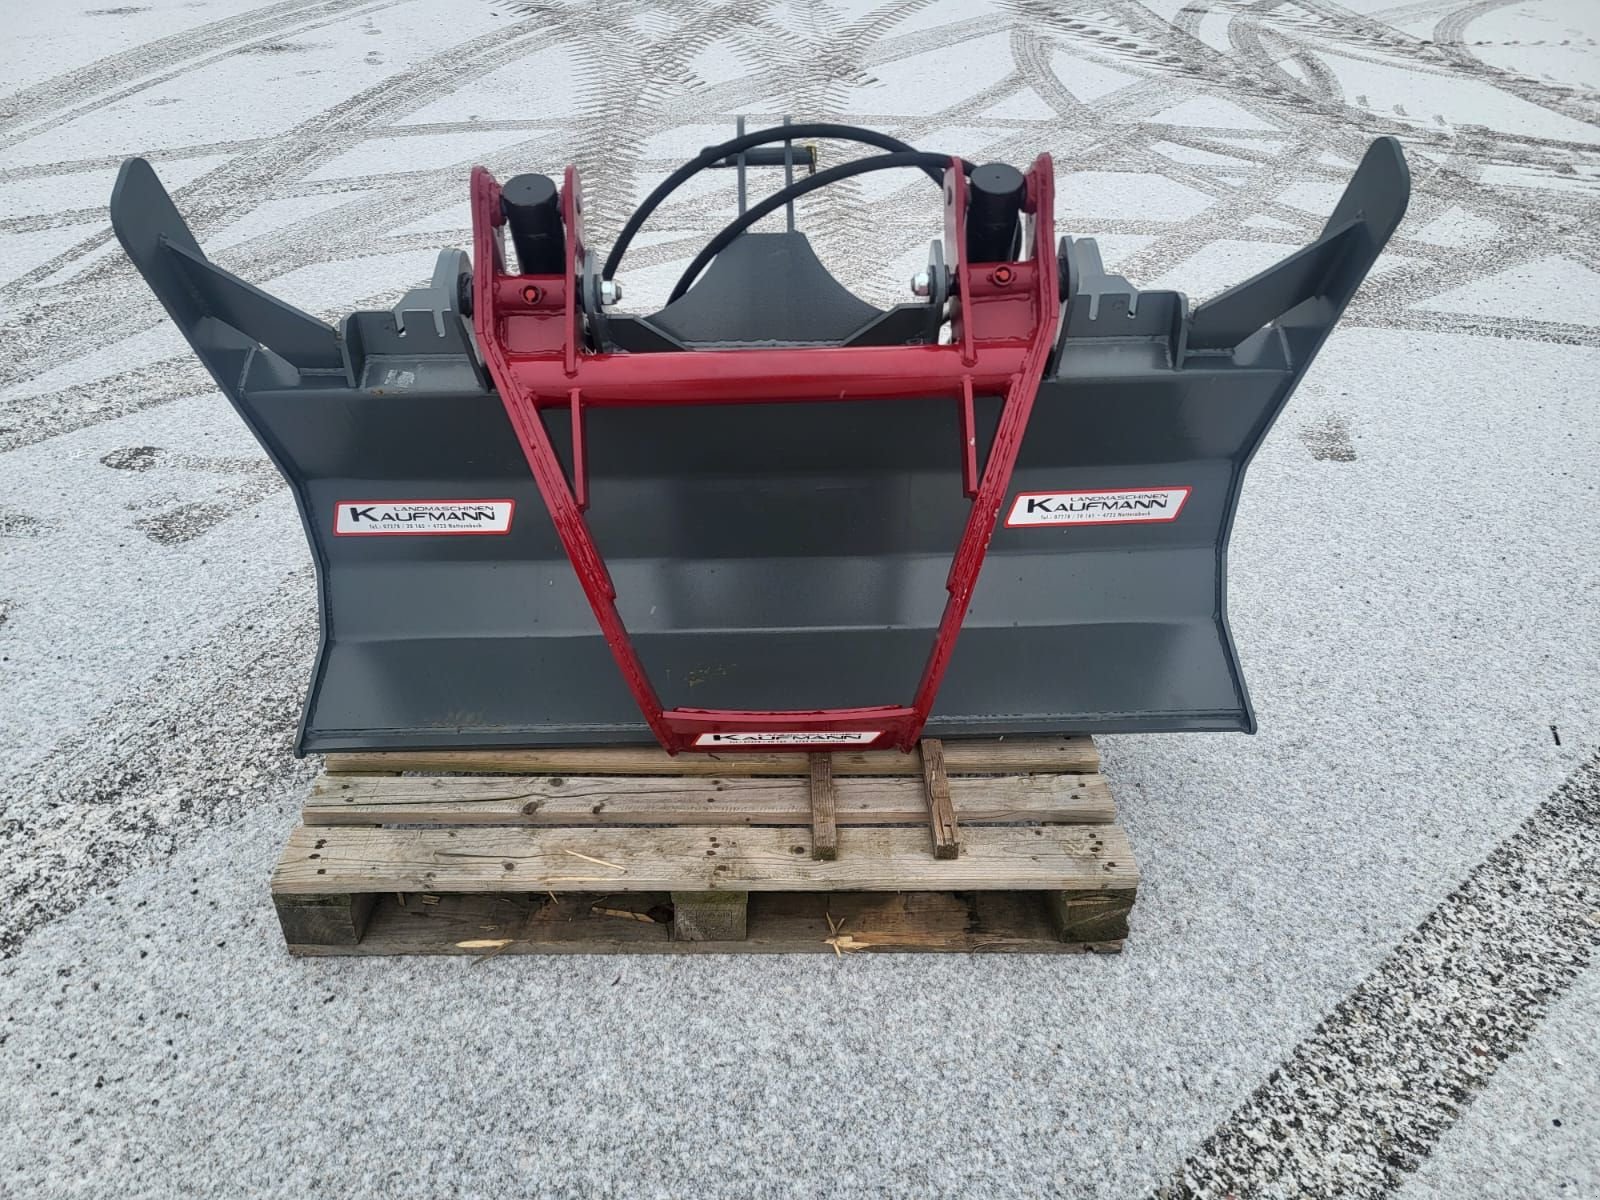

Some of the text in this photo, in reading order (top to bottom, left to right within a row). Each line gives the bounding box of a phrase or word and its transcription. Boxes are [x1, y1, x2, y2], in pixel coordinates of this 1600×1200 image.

[1070, 493, 1168, 502] LANDMASCHINEN
[1027, 498, 1168, 513] KAUFMANN
[350, 506, 495, 522] KAUFMANN
